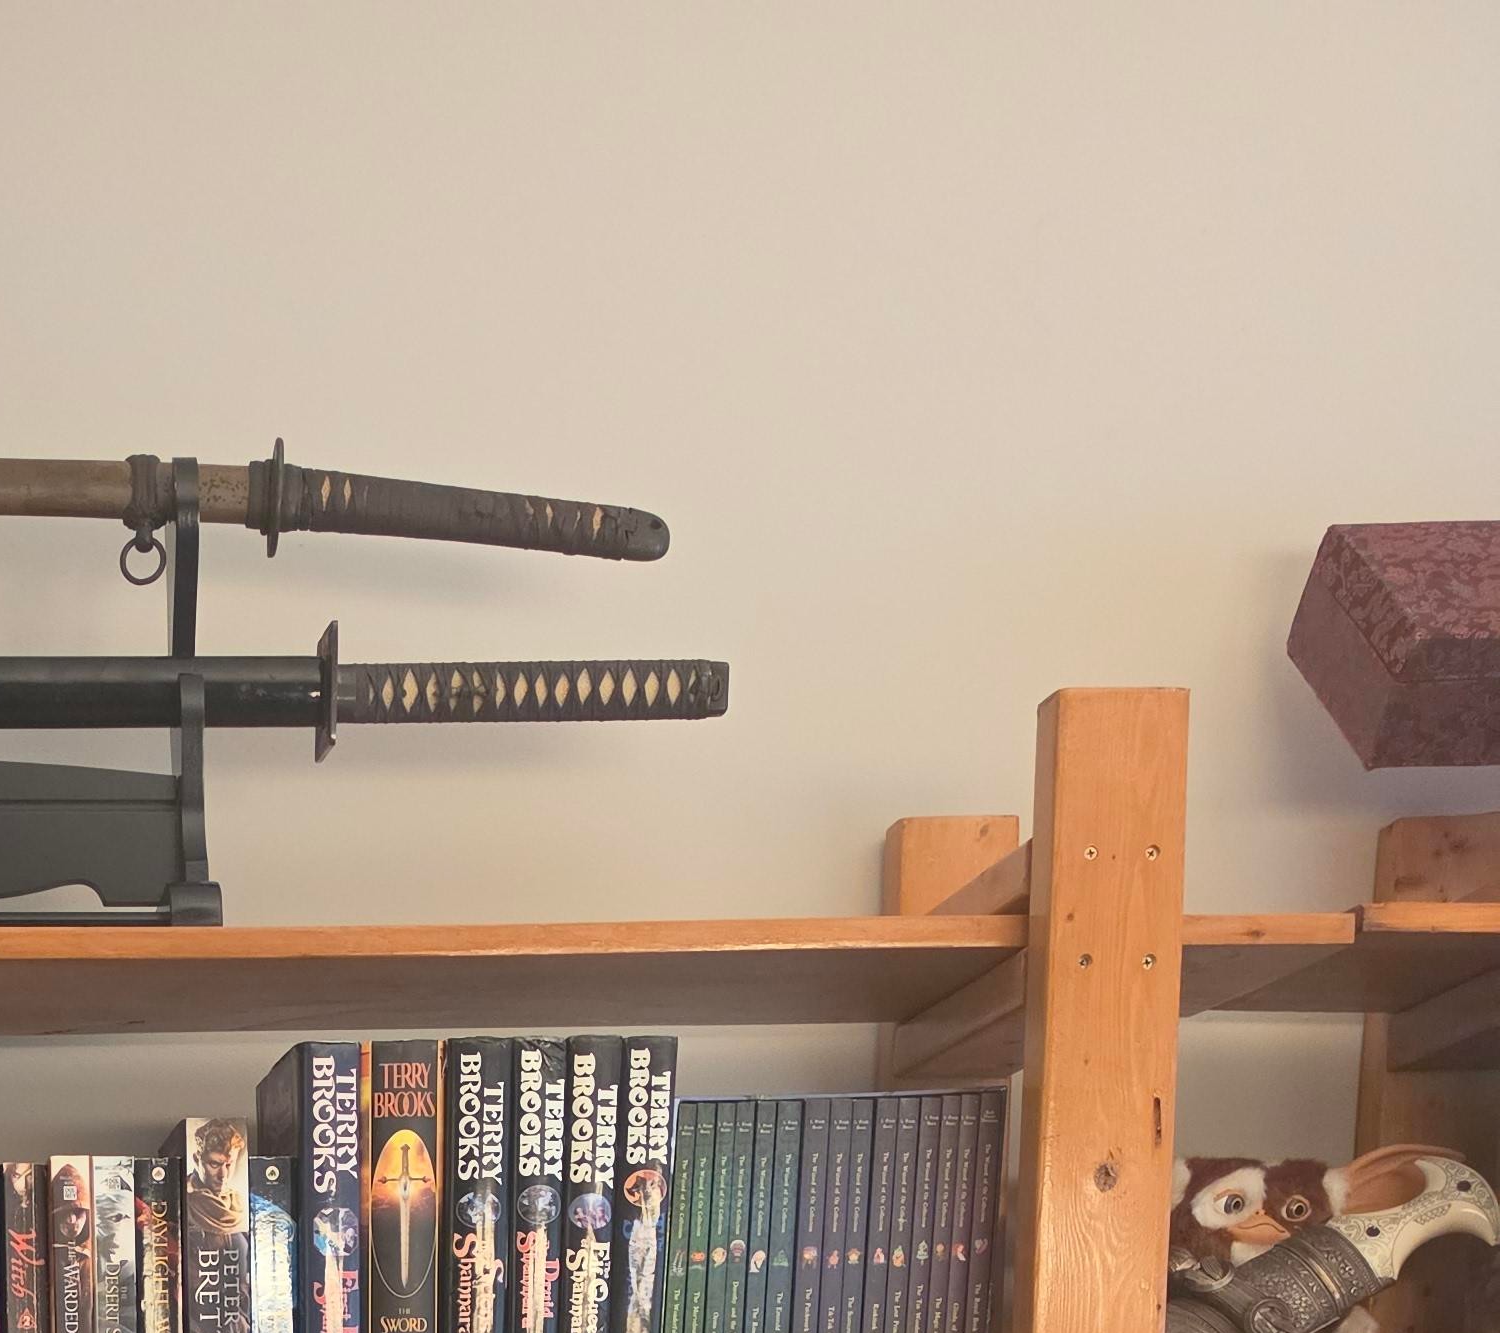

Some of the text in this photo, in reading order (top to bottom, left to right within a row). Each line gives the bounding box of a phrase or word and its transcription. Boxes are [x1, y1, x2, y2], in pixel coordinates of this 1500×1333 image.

[313, 1056, 335, 1194] BROOKS
[335, 1070, 357, 1180] TERRY
[379, 1063, 431, 1088] TERRY
[458, 1052, 481, 1181] BROOKS
[518, 1049, 542, 1177] BROOKS
[544, 1079, 564, 1181] TERRY
[570, 1054, 595, 1184] BROOKS
[626, 1049, 650, 1165] BROOKS
[649, 1071, 671, 1166] TERRY
[482, 1082, 505, 1185] TERRY
[595, 1085, 618, 1188] TERRY
